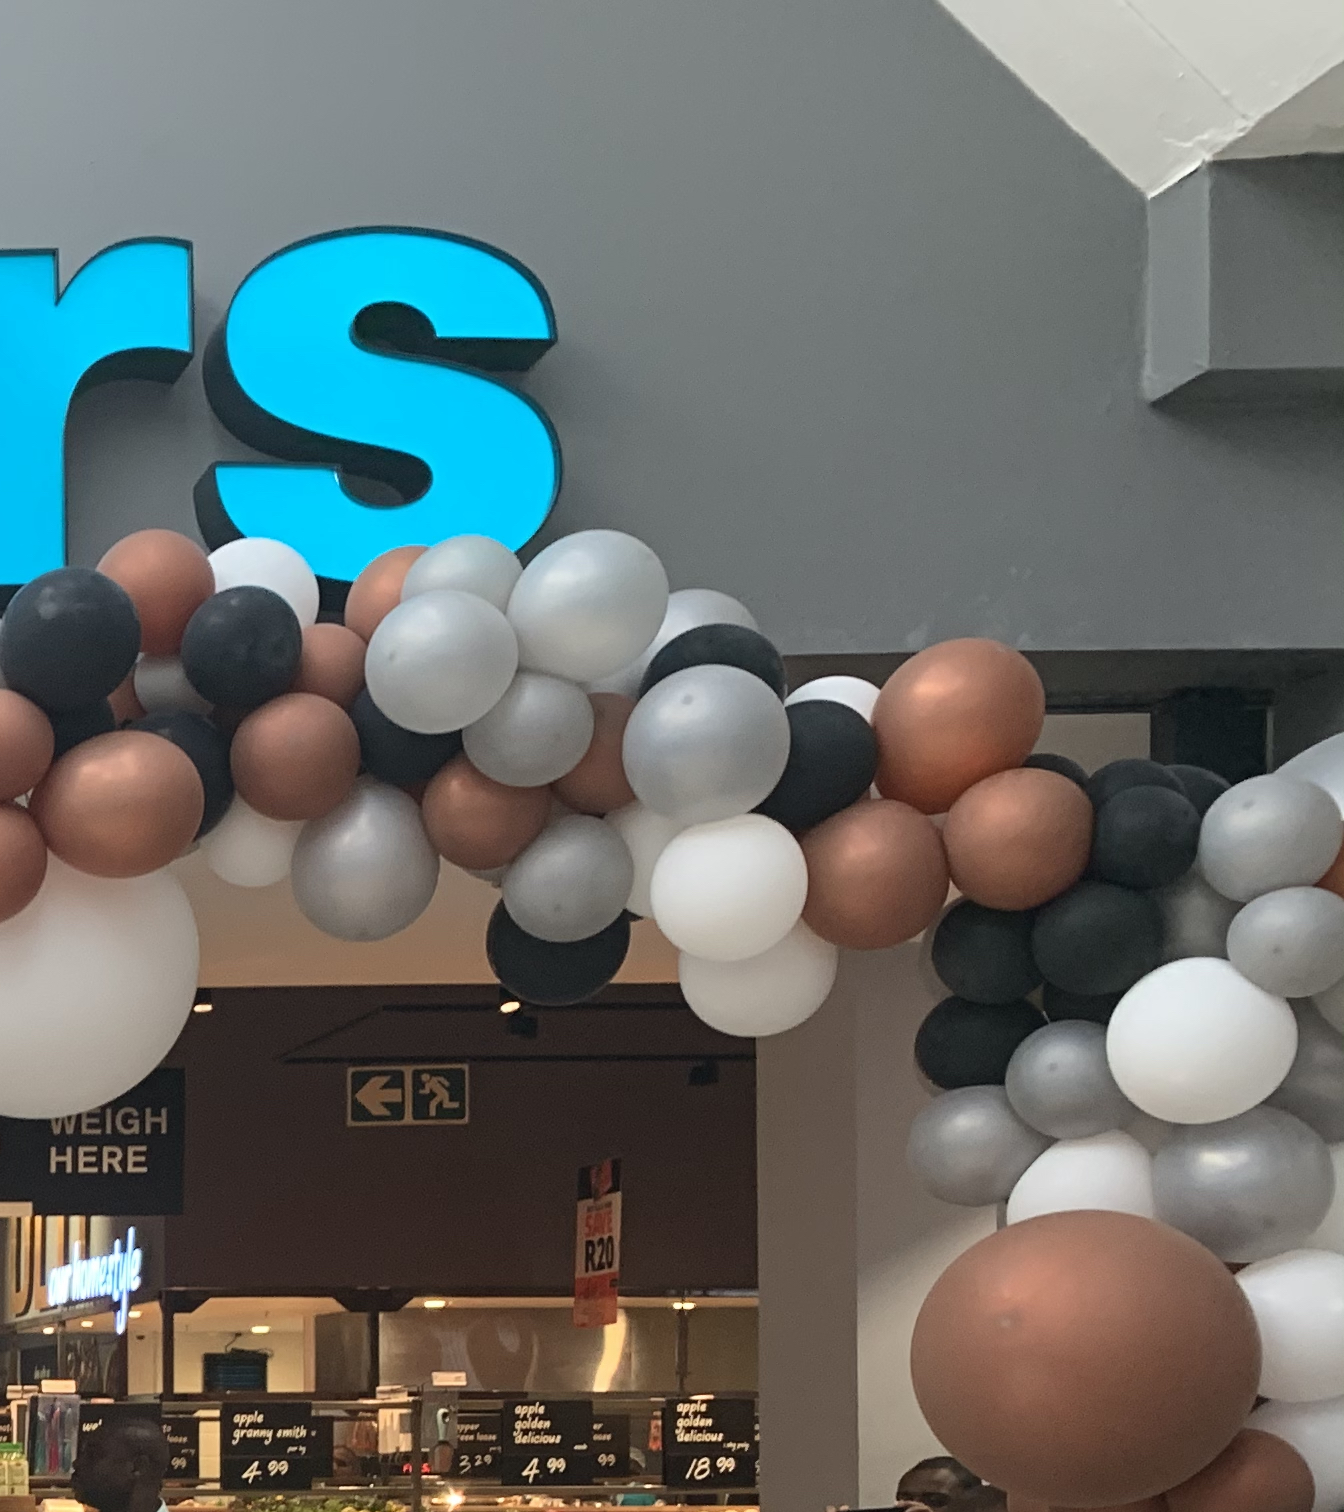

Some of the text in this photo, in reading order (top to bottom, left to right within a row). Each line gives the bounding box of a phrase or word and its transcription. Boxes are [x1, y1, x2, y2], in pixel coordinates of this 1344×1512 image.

[50, 1107, 168, 1136] WEIGH
[50, 1145, 149, 1174] HERE
[584, 1235, 614, 1273] R20
[514, 1401, 546, 1416] apple
[676, 1402, 707, 1416] apple
[233, 1411, 264, 1430] apple
[513, 1416, 551, 1436] golden
[675, 1414, 713, 1434] golden
[231, 1425, 307, 1445] granny smith
[514, 1432, 562, 1445] delicious
[676, 1430, 724, 1443] delicious
